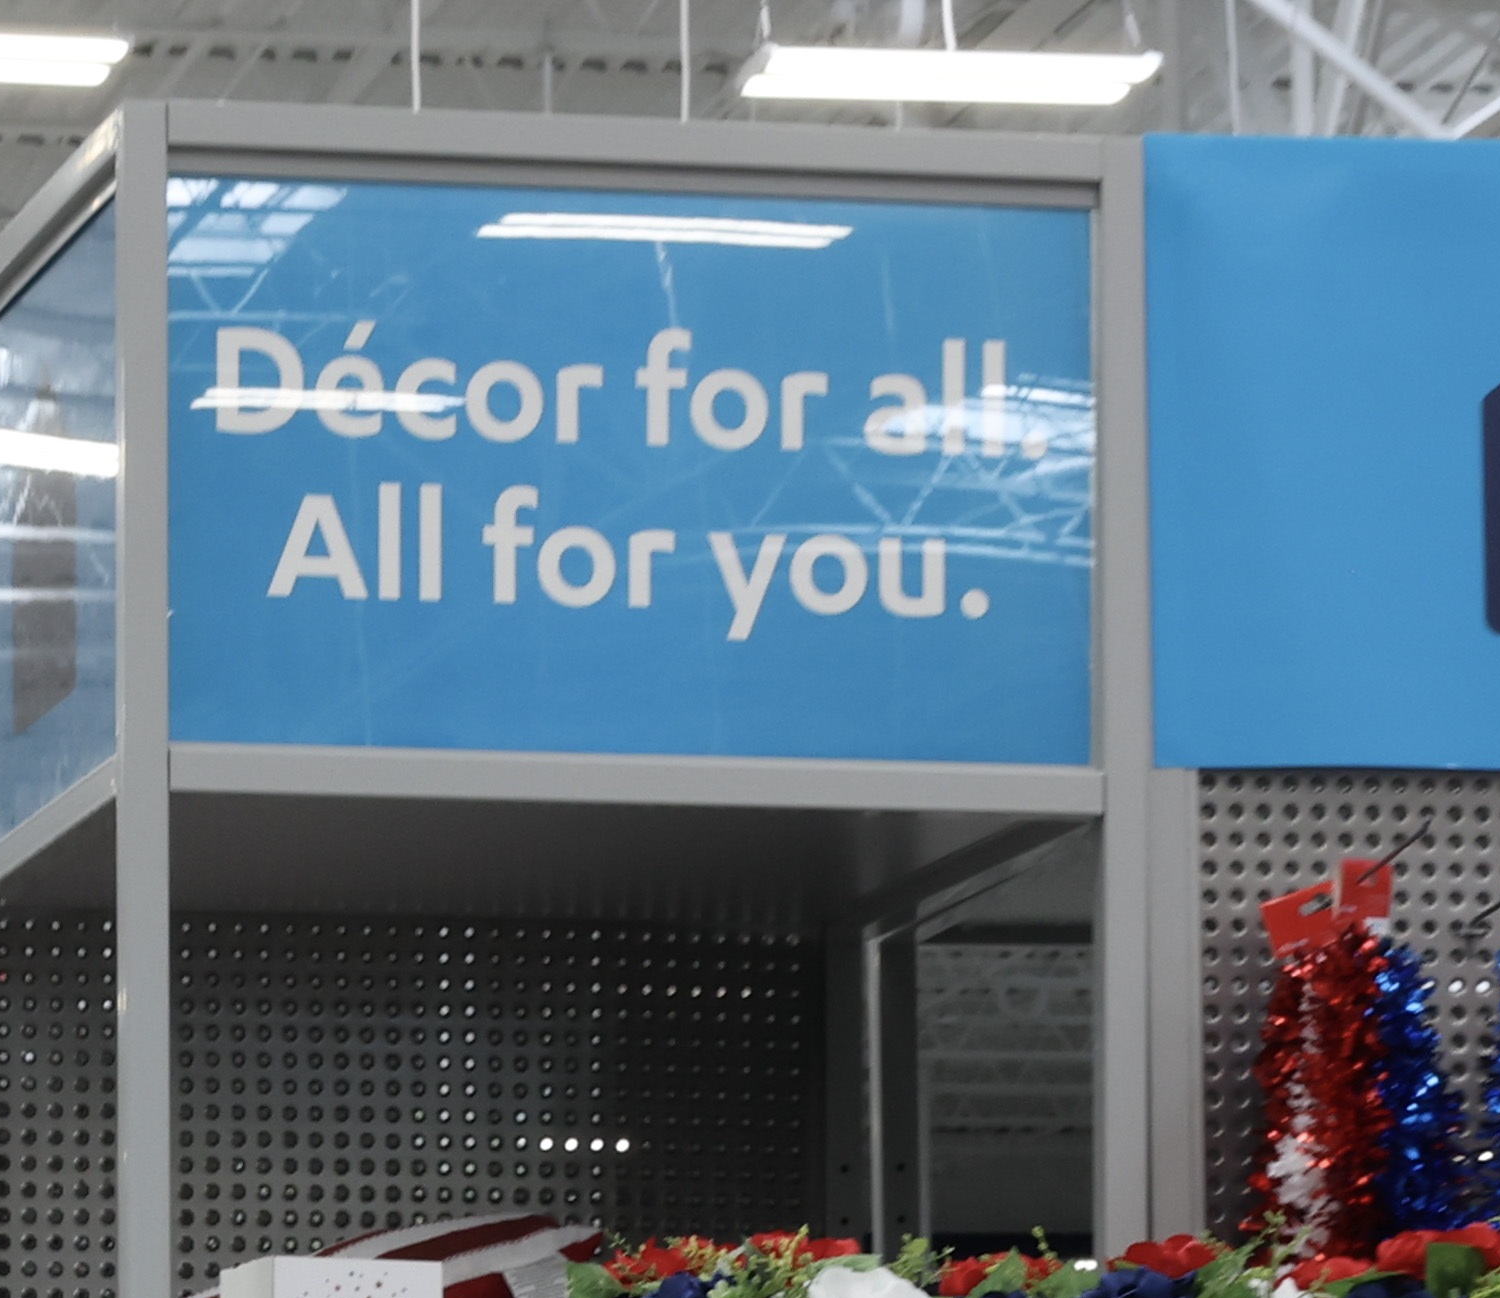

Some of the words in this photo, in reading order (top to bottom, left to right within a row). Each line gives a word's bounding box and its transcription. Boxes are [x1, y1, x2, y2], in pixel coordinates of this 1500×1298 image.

[215, 320, 603, 443] Décor
[636, 328, 828, 451] for
[267, 482, 442, 601] All
[482, 485, 676, 608] for
[708, 531, 989, 642] you.
